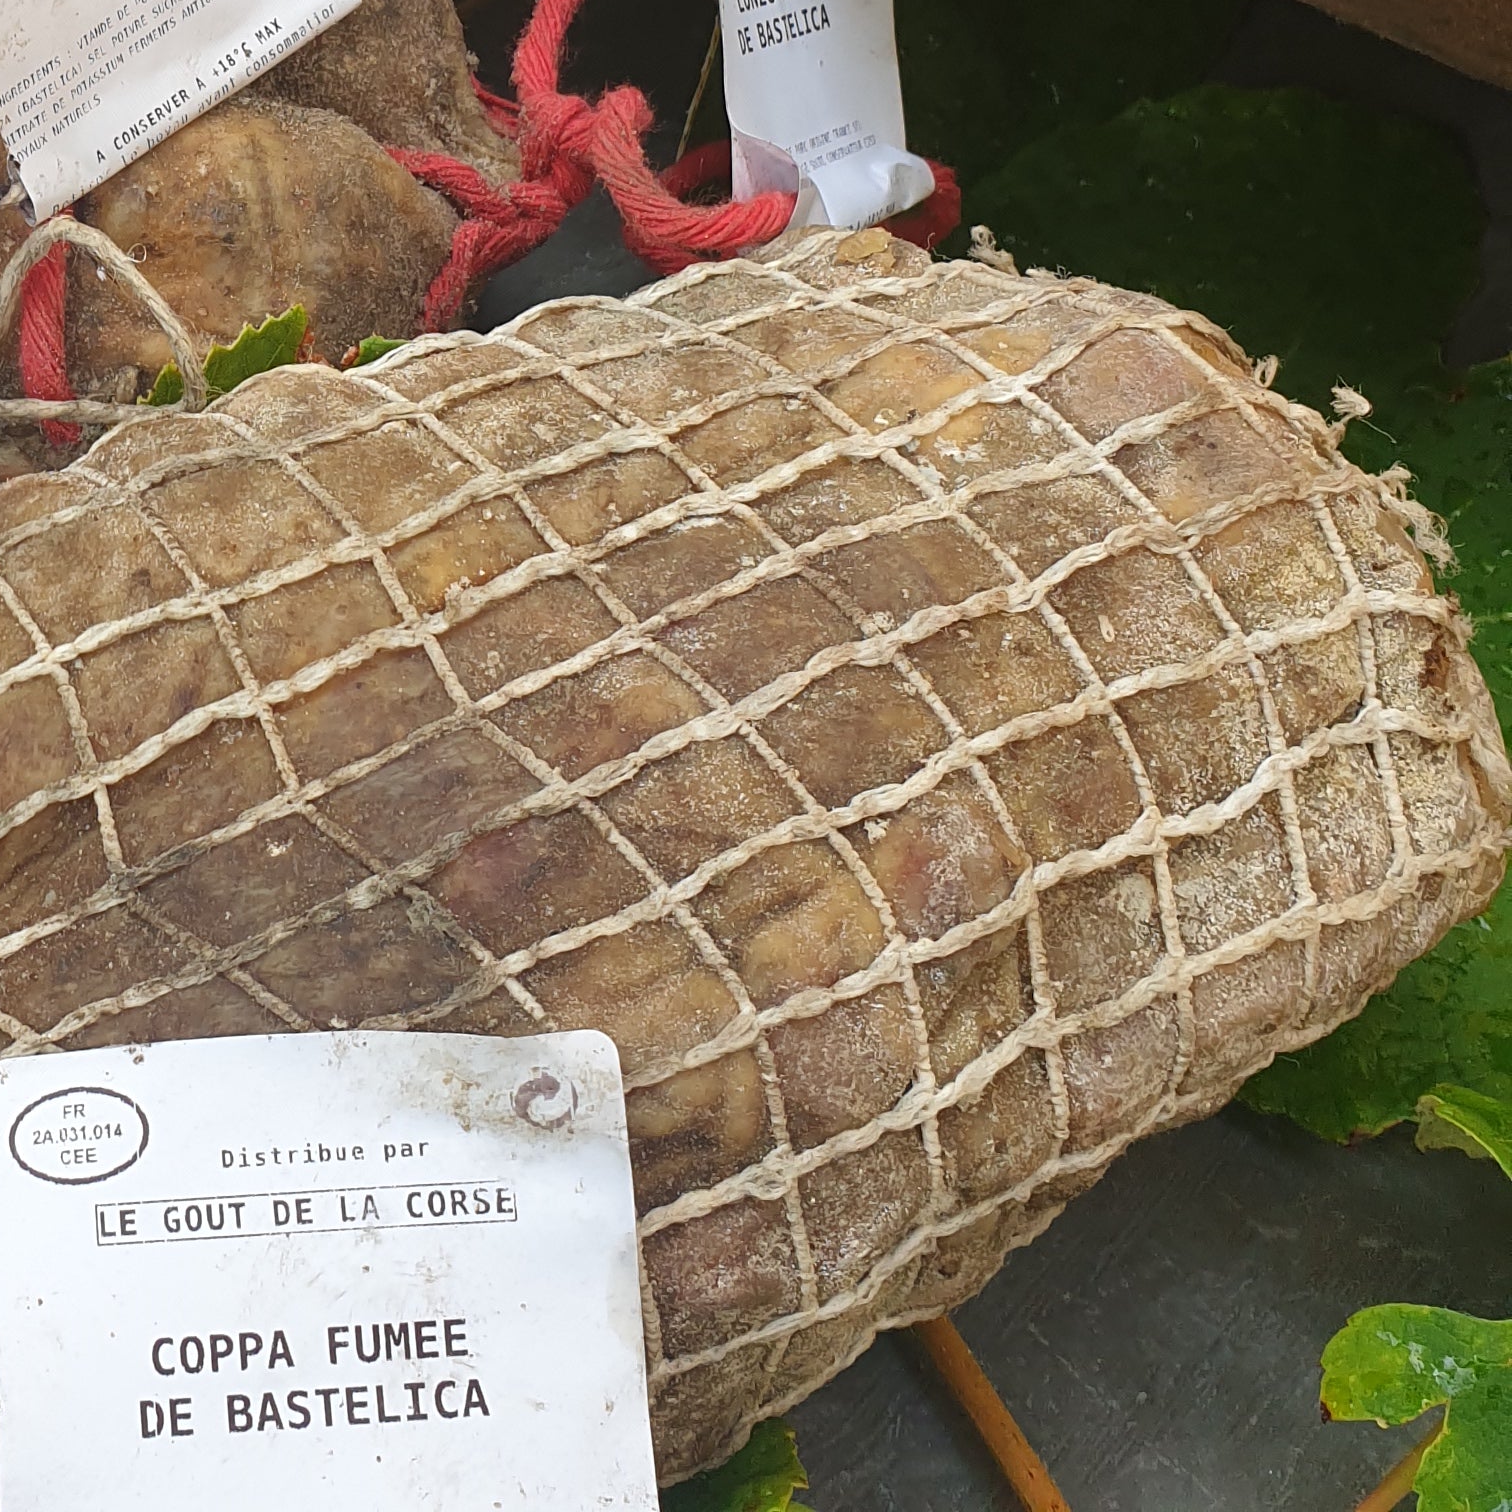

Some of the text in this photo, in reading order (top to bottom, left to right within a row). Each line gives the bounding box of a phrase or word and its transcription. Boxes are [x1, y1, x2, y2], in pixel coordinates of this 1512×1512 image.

[76, 17, 113, 50] VIANDE
[116, 4, 130, 21] DE
[87, 46, 107, 65] SEL
[111, 14, 149, 47] POIVRE
[738, 4, 831, 55] DE BASTELICA
[53, 97, 66, 114] DE
[70, 53, 125, 100] POTASSIUM
[129, 17, 177, 56] FERMENTS
[96, 150, 107, 165] A
[113, 89, 190, 152] CONSERVER
[195, 76, 207, 91] A
[255, 17, 284, 45] MAX
[14, 93, 102, 164] OYAUX NATURELS
[32, 1123, 123, 1145] 2A.031.014
[63, 1104, 86, 1119] FR
[60, 1148, 98, 1165] CEE
[221, 1141, 430, 1169] Distribue par
[99, 1187, 515, 1237] LE GOUT DE LA CORSE
[151, 1318, 469, 1376] COPPA FUMEE
[139, 1378, 491, 1438] DE BASTELICA
